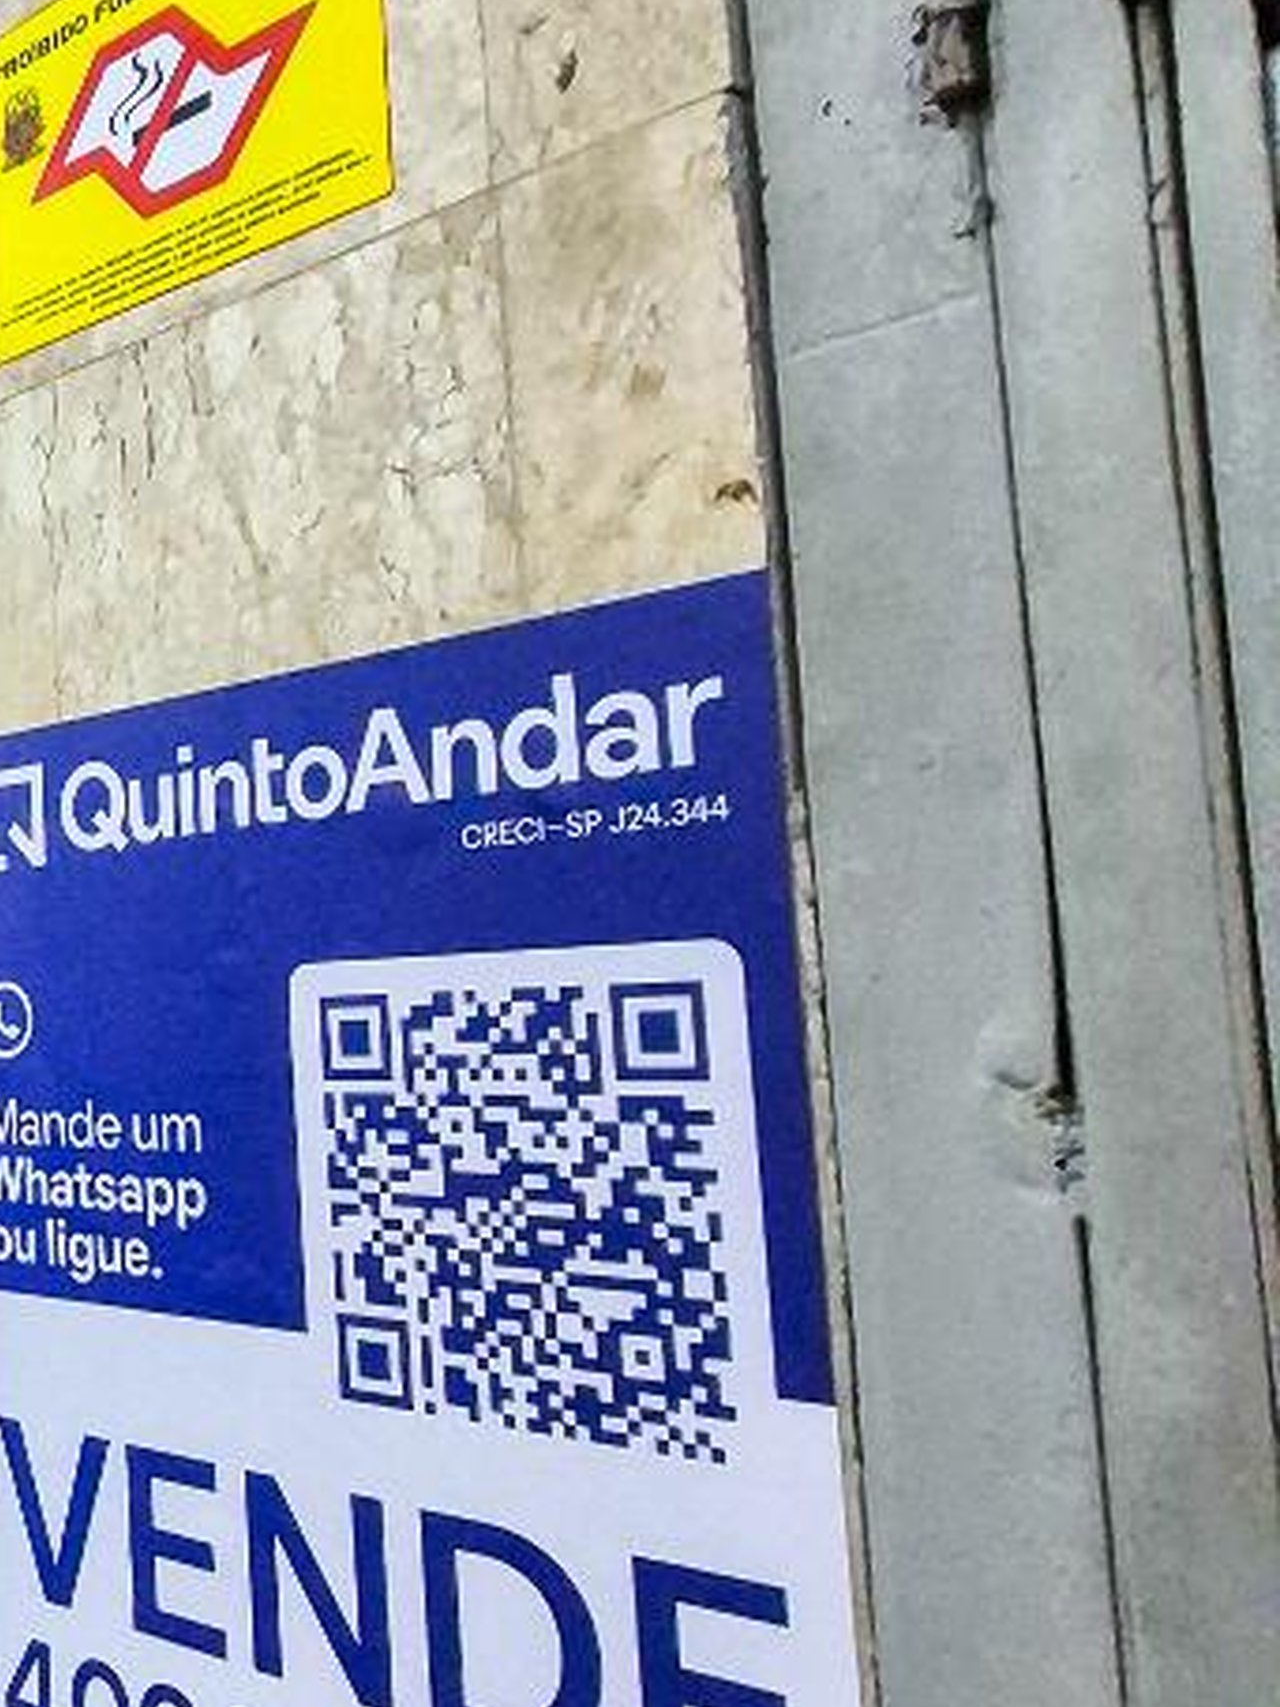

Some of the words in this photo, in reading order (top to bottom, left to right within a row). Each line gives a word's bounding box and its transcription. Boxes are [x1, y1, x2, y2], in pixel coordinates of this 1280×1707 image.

[59, 673, 725, 854] QuintoAndar
[460, 809, 603, 850] CRECI-SP
[608, 794, 731, 834] J24.344
[131, 1112, 203, 1154] um
[45, 1217, 165, 1284] ligue.
